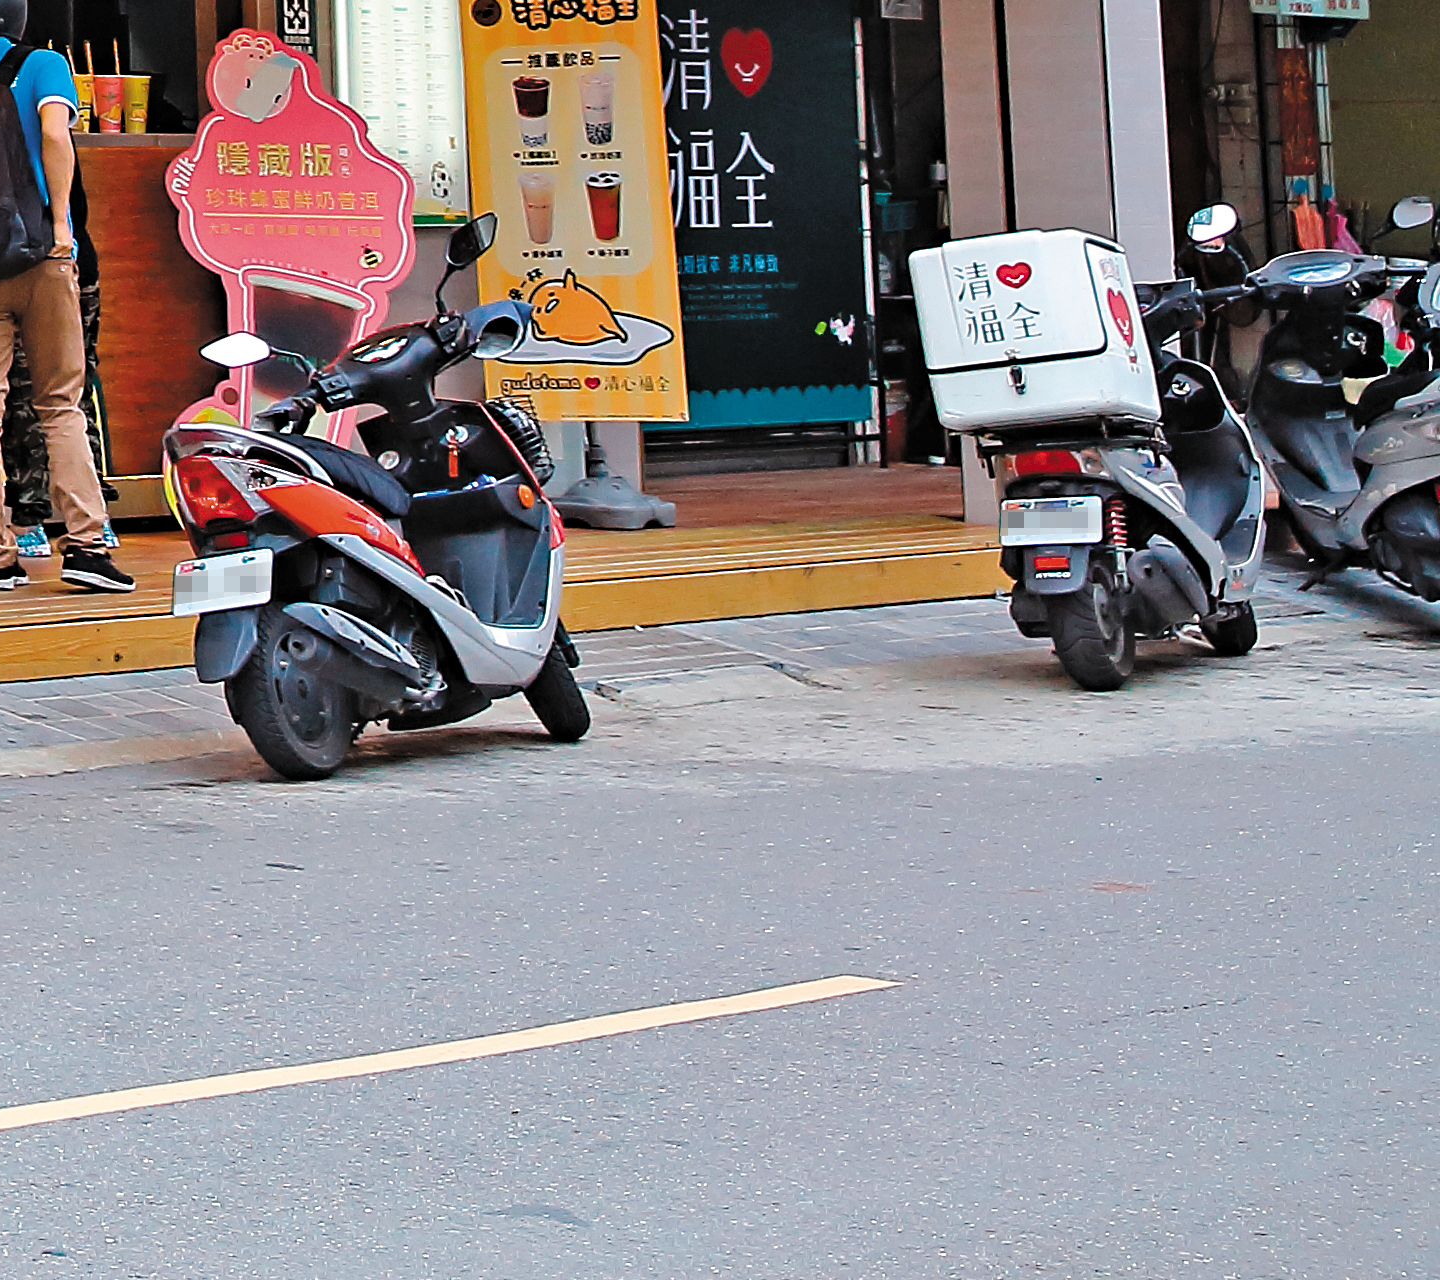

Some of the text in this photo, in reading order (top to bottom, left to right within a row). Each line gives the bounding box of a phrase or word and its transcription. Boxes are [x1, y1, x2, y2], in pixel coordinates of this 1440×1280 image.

[660, 10, 711, 110] 清
[217, 141, 332, 177] 隱藏版
[668, 128, 775, 228] 福全
[953, 262, 991, 302] 清
[964, 302, 1042, 345] 福全
[501, 372, 581, 395] gudetama
